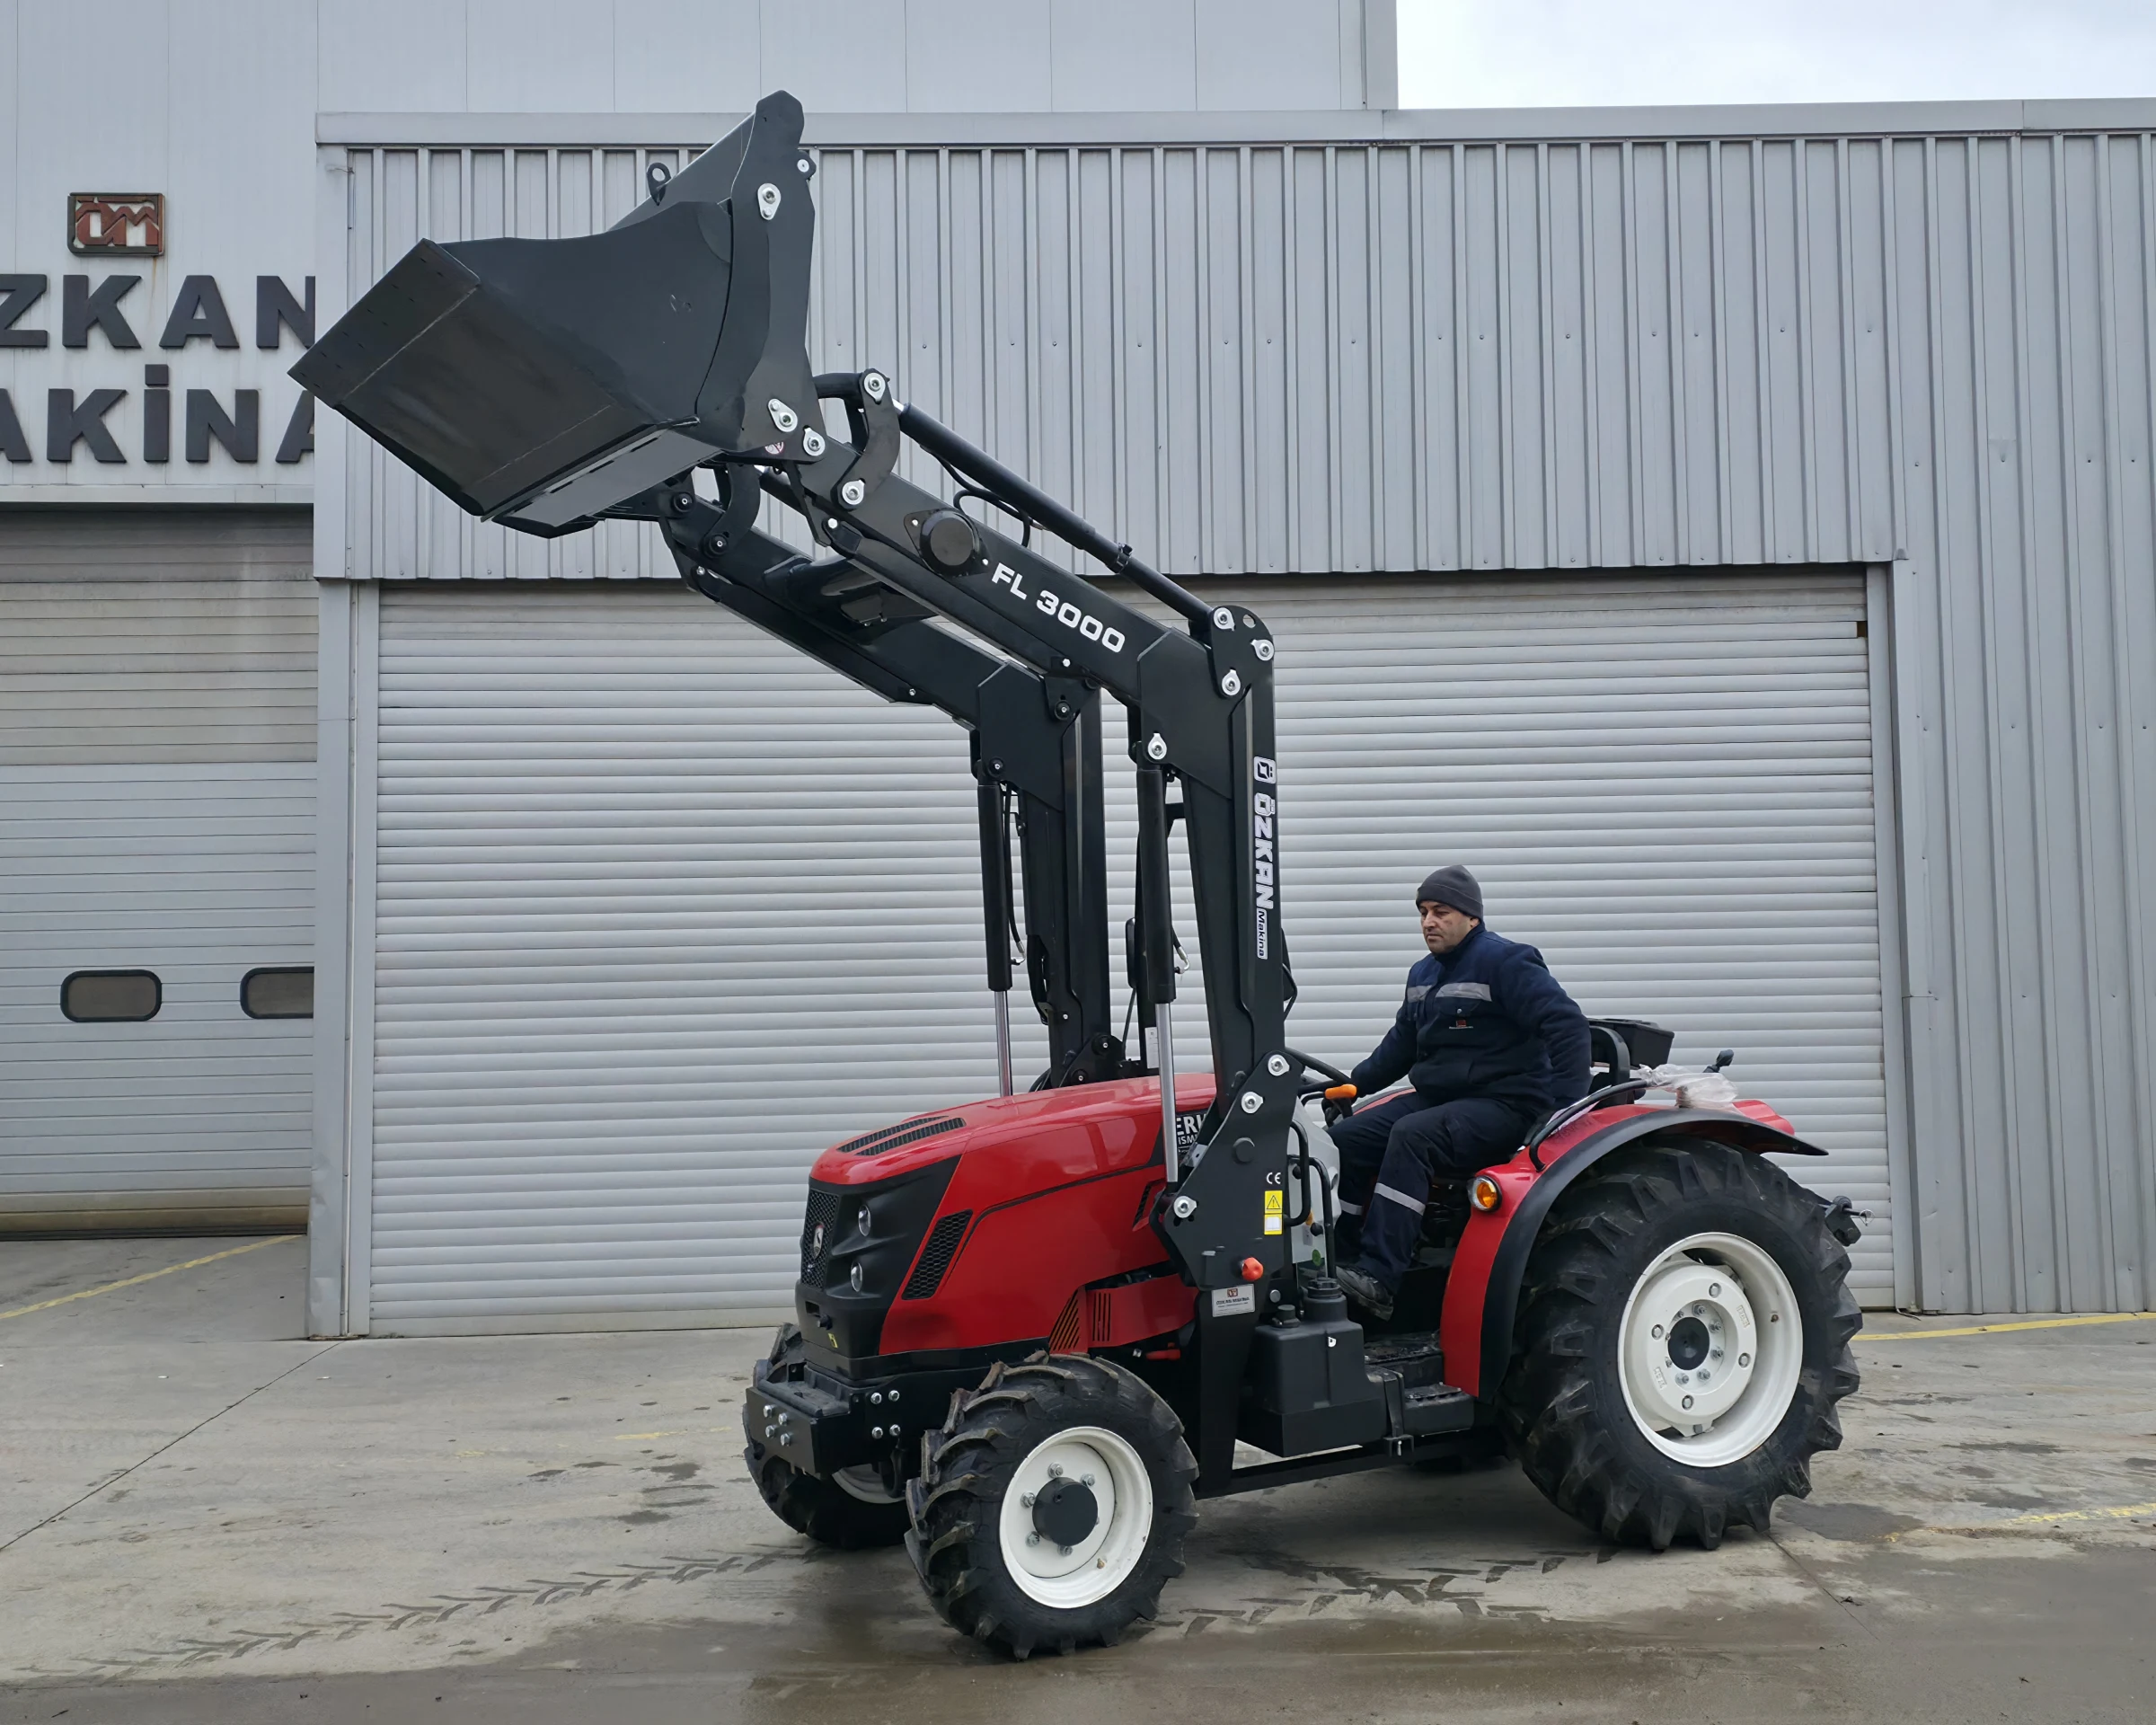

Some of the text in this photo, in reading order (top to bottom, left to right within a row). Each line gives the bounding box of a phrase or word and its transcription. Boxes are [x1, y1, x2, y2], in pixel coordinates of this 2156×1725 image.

[991, 562, 1126, 653] FL 3000
[1254, 792, 1275, 957] ÖZKAN Makina
